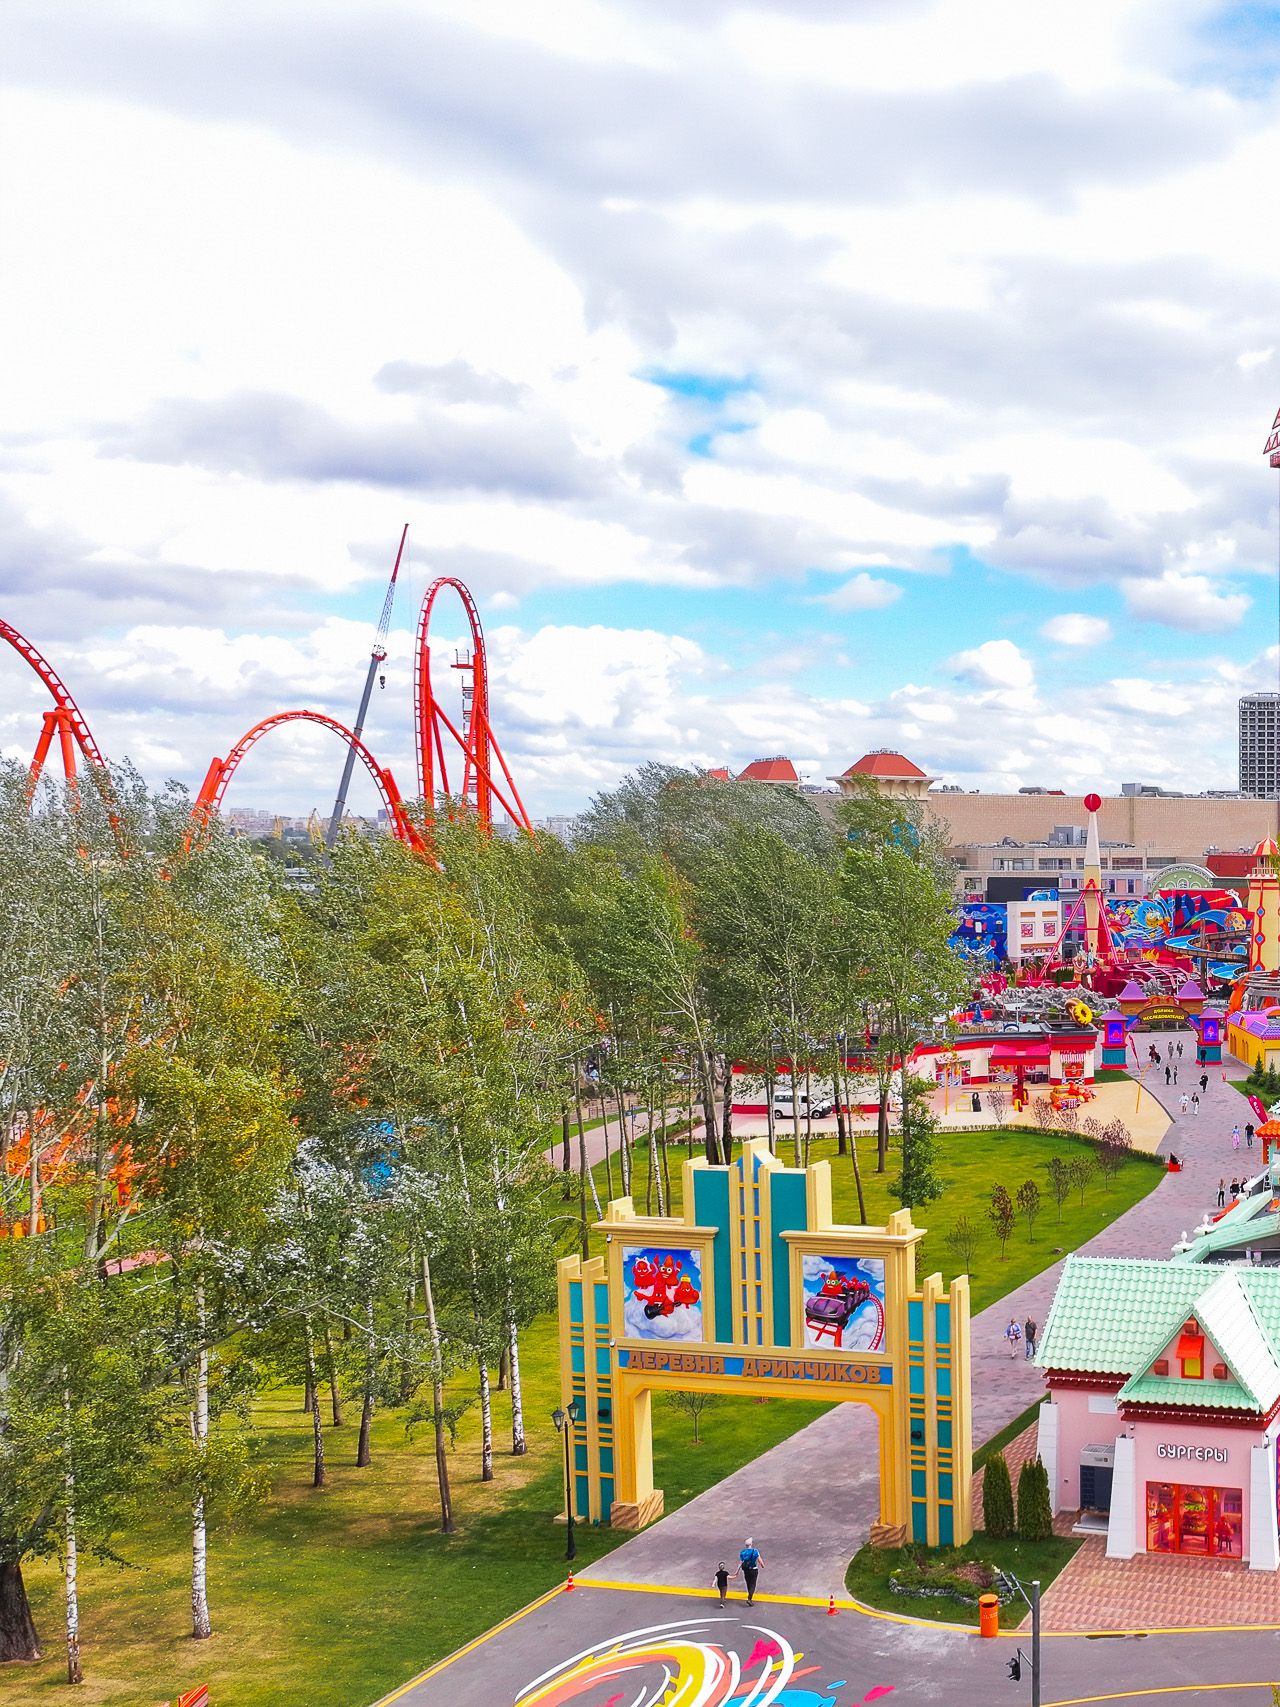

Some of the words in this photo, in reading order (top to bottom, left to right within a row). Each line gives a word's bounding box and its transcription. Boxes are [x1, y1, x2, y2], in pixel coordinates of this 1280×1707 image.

[627, 1350, 725, 1375] ДЕРЕВНЯ
[742, 1357, 881, 1384] ДРИМЧИКОВ
[1156, 1443, 1228, 1463] БУРГЕРЫ
